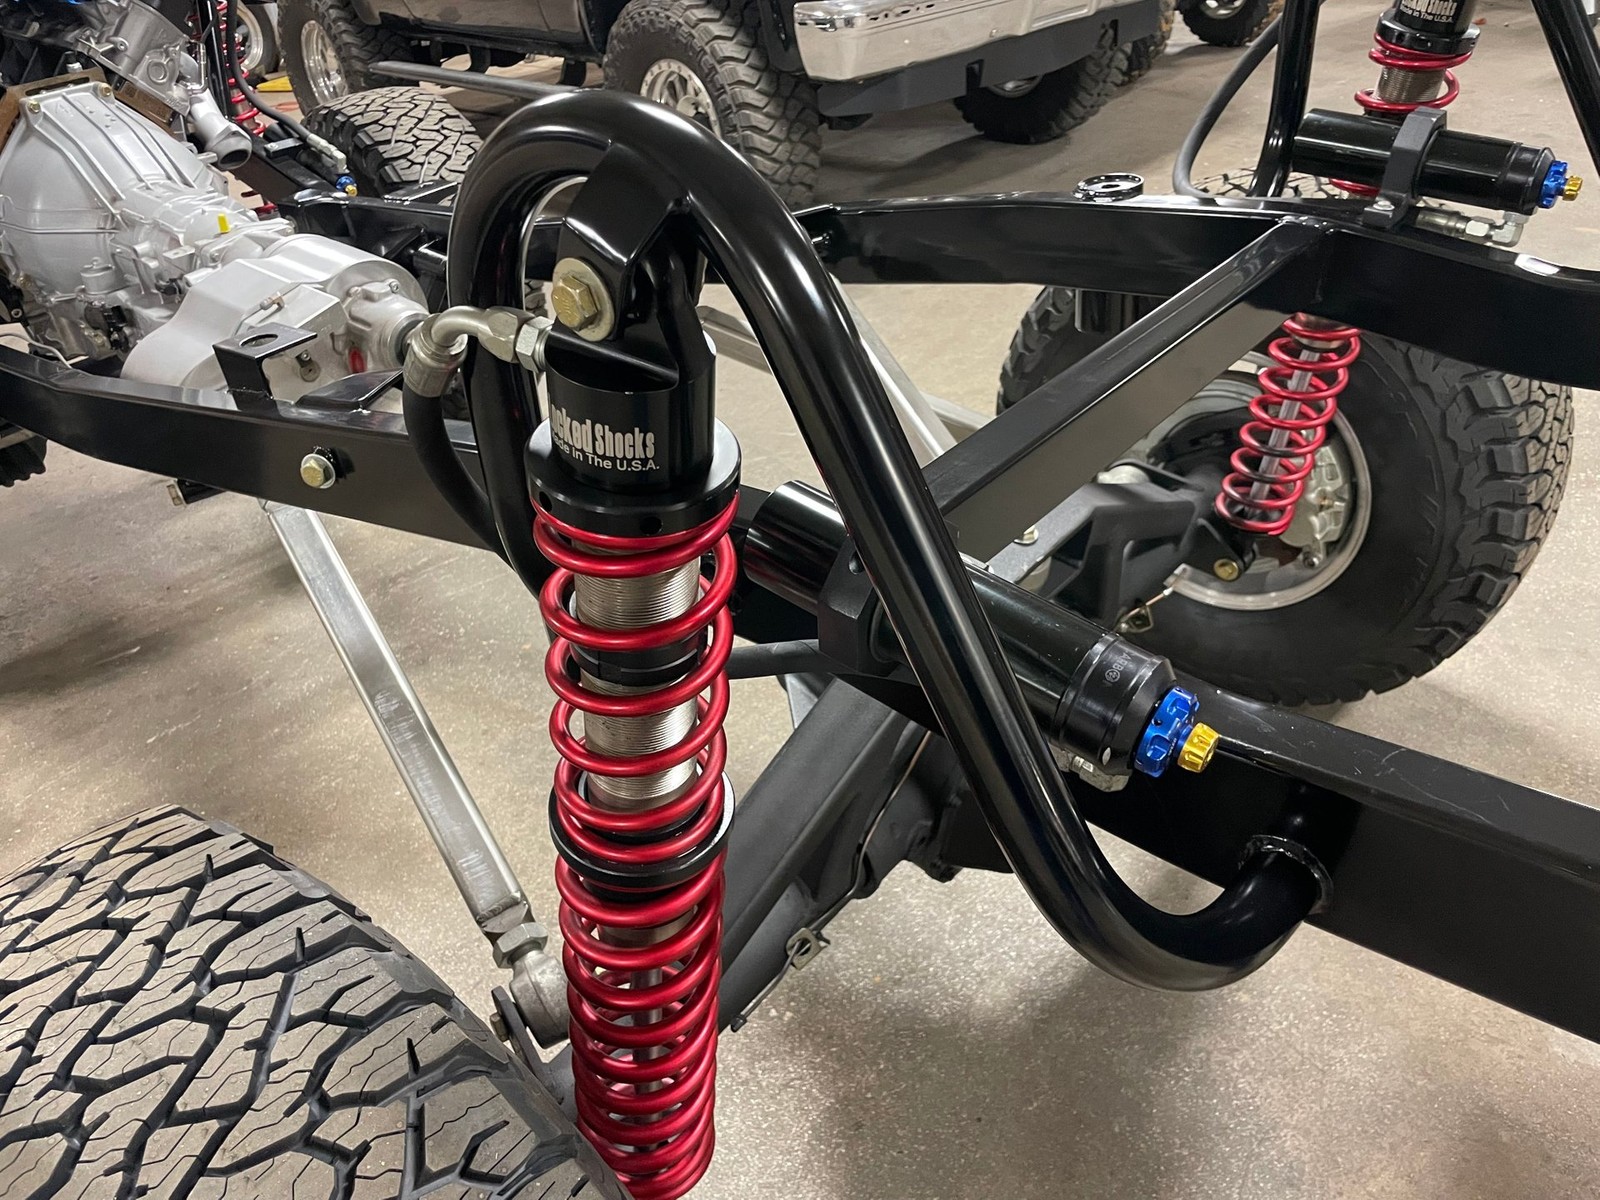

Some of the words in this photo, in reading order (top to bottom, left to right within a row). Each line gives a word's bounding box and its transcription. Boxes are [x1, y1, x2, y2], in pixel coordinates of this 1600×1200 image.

[551, 403, 594, 454] ocked
[594, 422, 655, 459] Shocks
[552, 430, 570, 454] ade
[572, 447, 583, 461] In
[585, 452, 612, 469] The
[616, 459, 660, 471] U.S.A.
